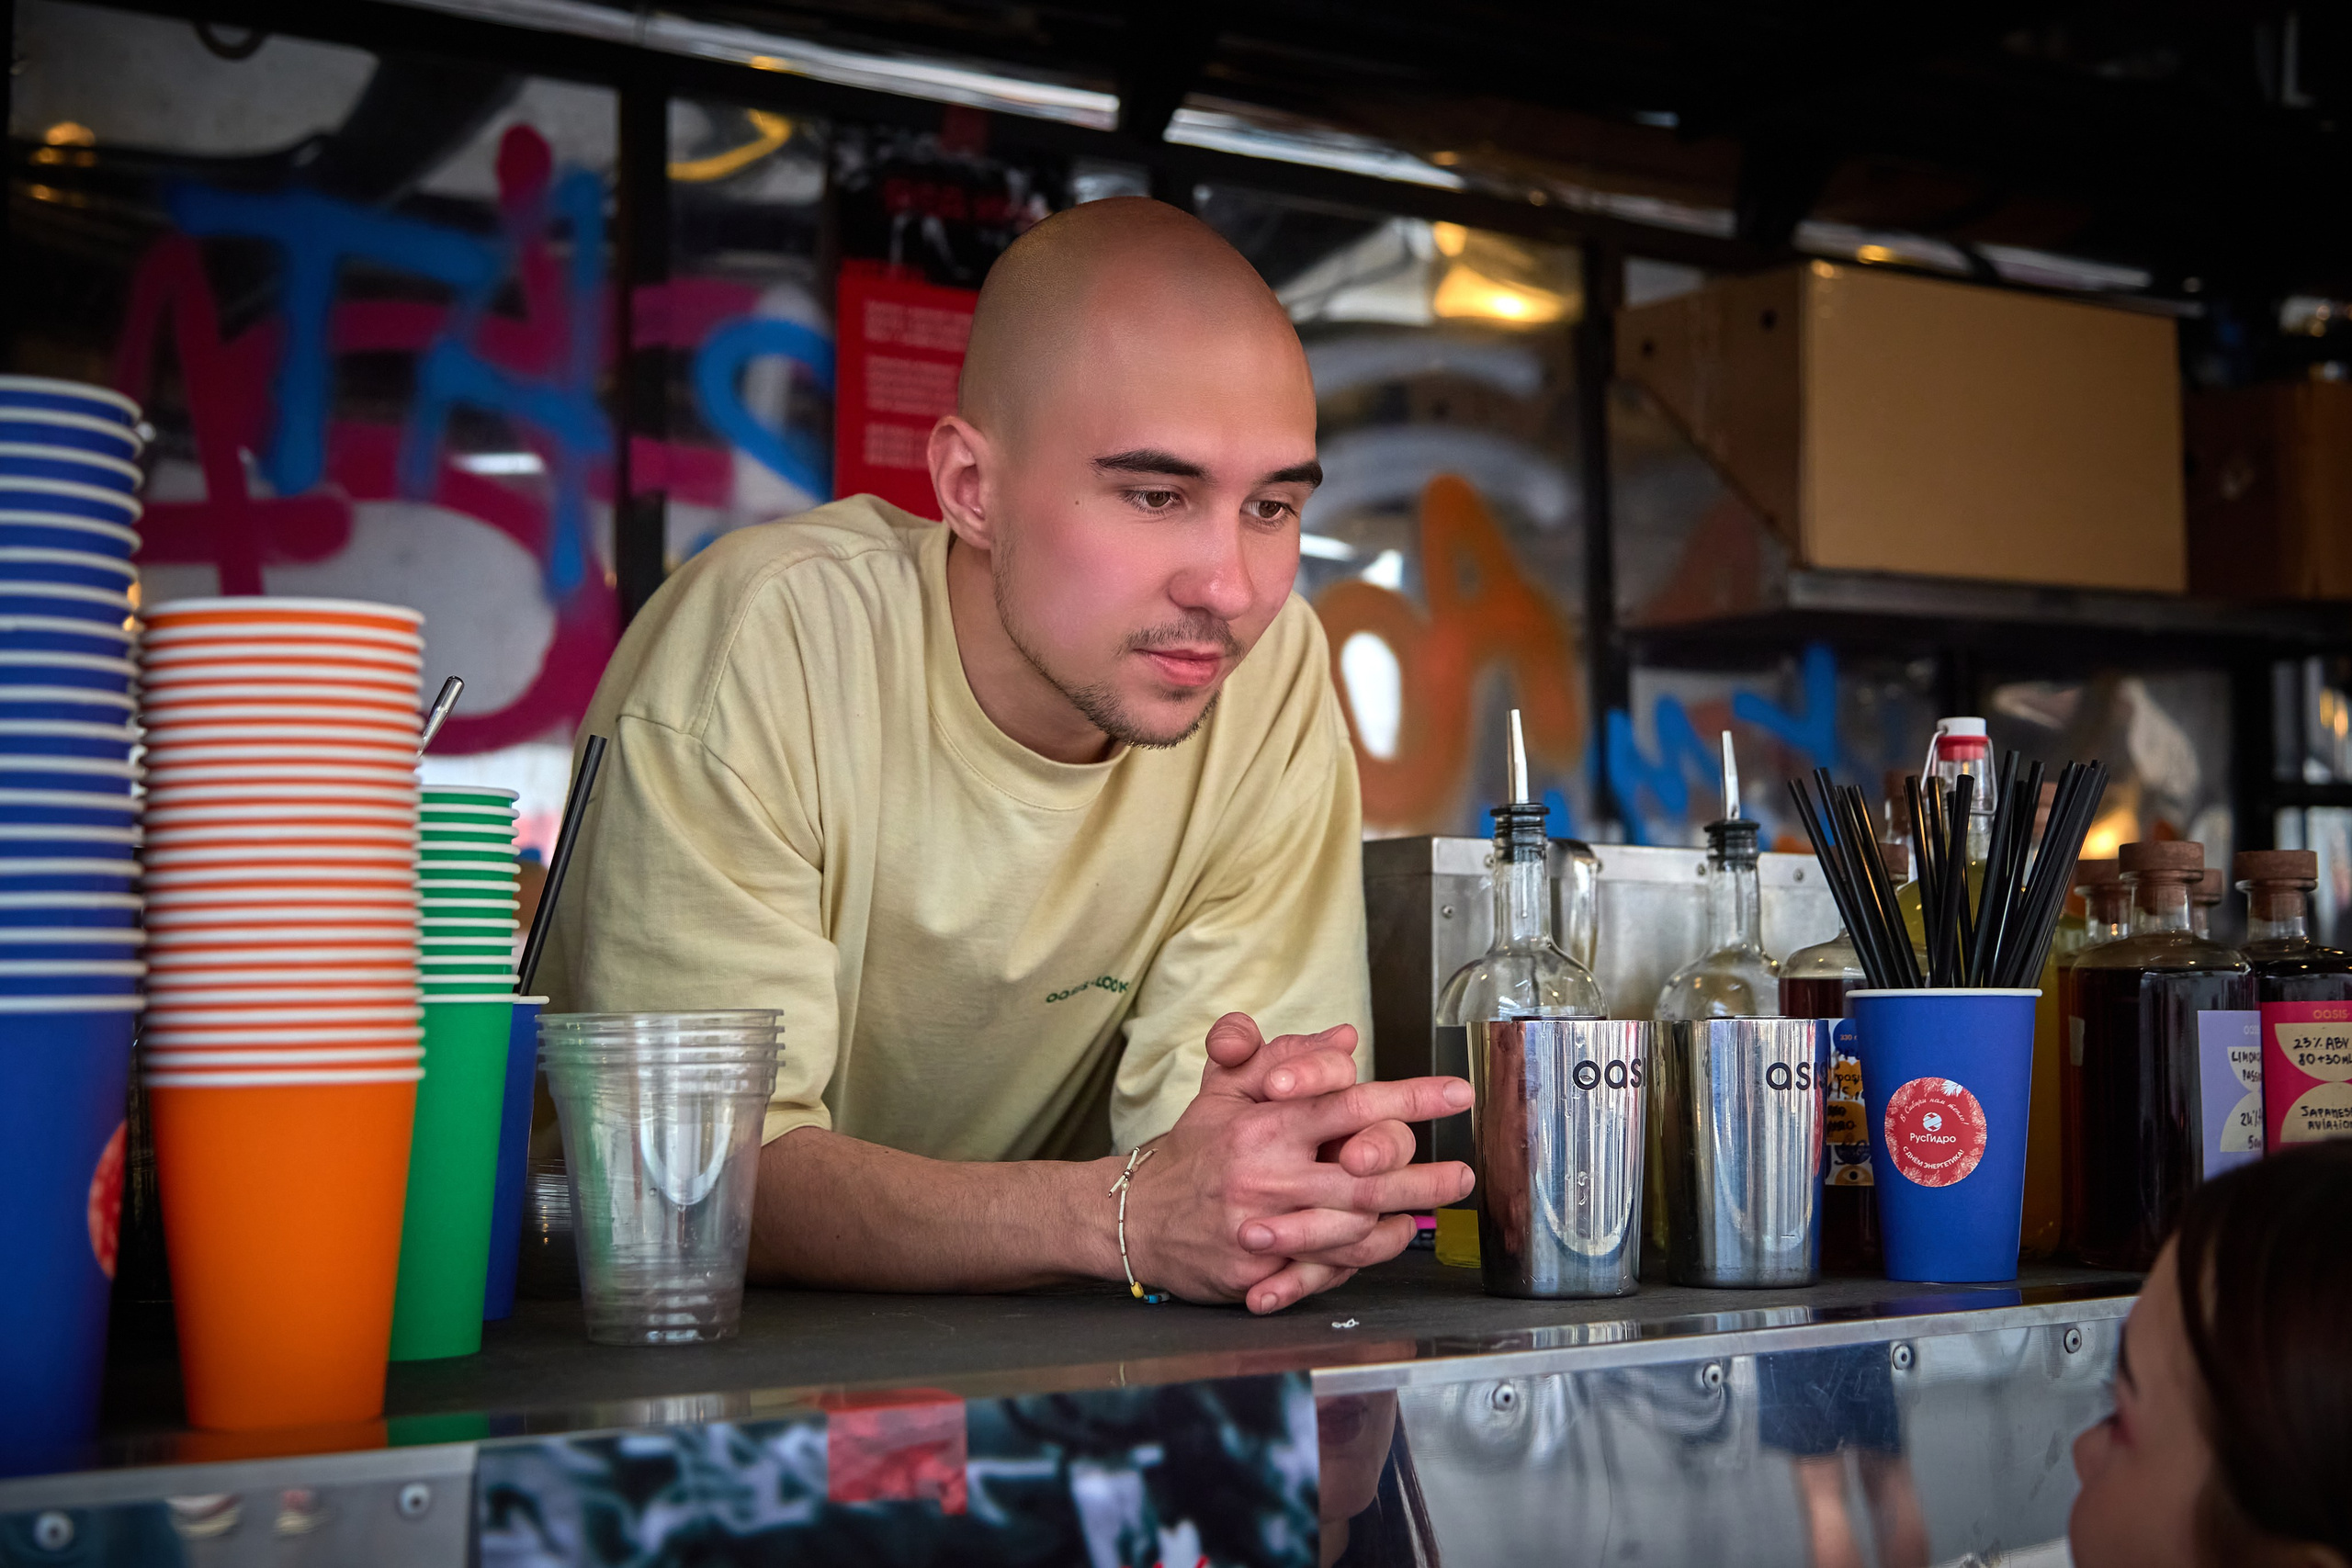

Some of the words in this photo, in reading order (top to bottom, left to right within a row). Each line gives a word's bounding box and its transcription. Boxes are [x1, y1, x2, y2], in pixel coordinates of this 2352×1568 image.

[2325, 1037, 2349, 1051] ABV
[1909, 1133, 1957, 1145] РусГидро
[1924, 1149, 1964, 1169] ЭНЕРГЕТИКА!
